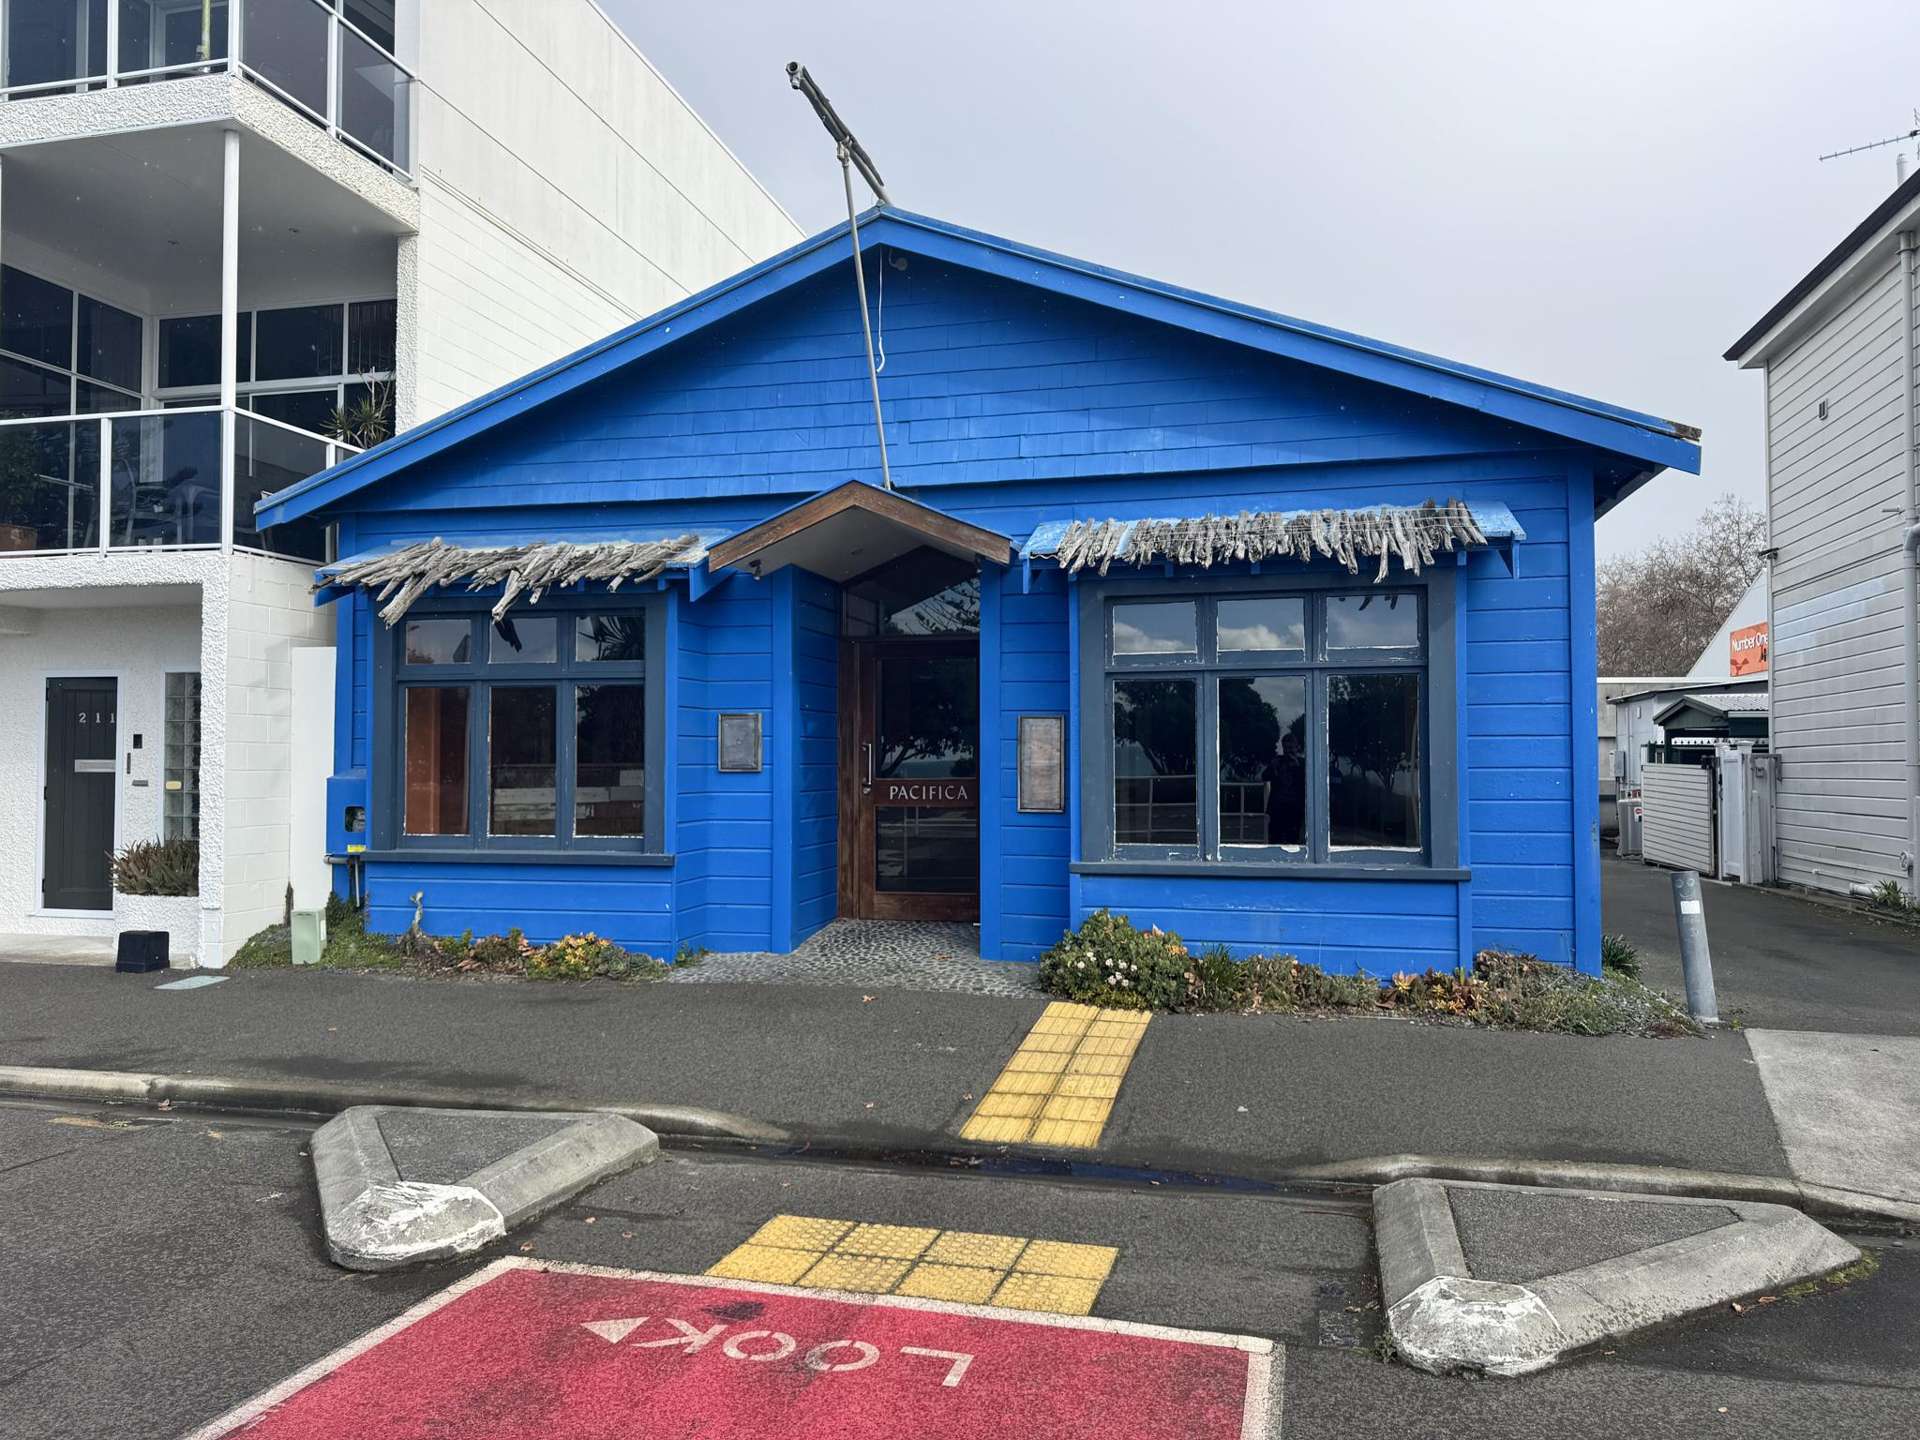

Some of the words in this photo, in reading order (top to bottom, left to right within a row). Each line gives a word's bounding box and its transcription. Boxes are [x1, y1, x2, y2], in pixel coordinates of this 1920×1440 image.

[1732, 635, 1755, 652] Number
[78, 711, 116, 724] 211
[889, 784, 968, 800] PACIFICA
[631, 1317, 975, 1388] LOOK
